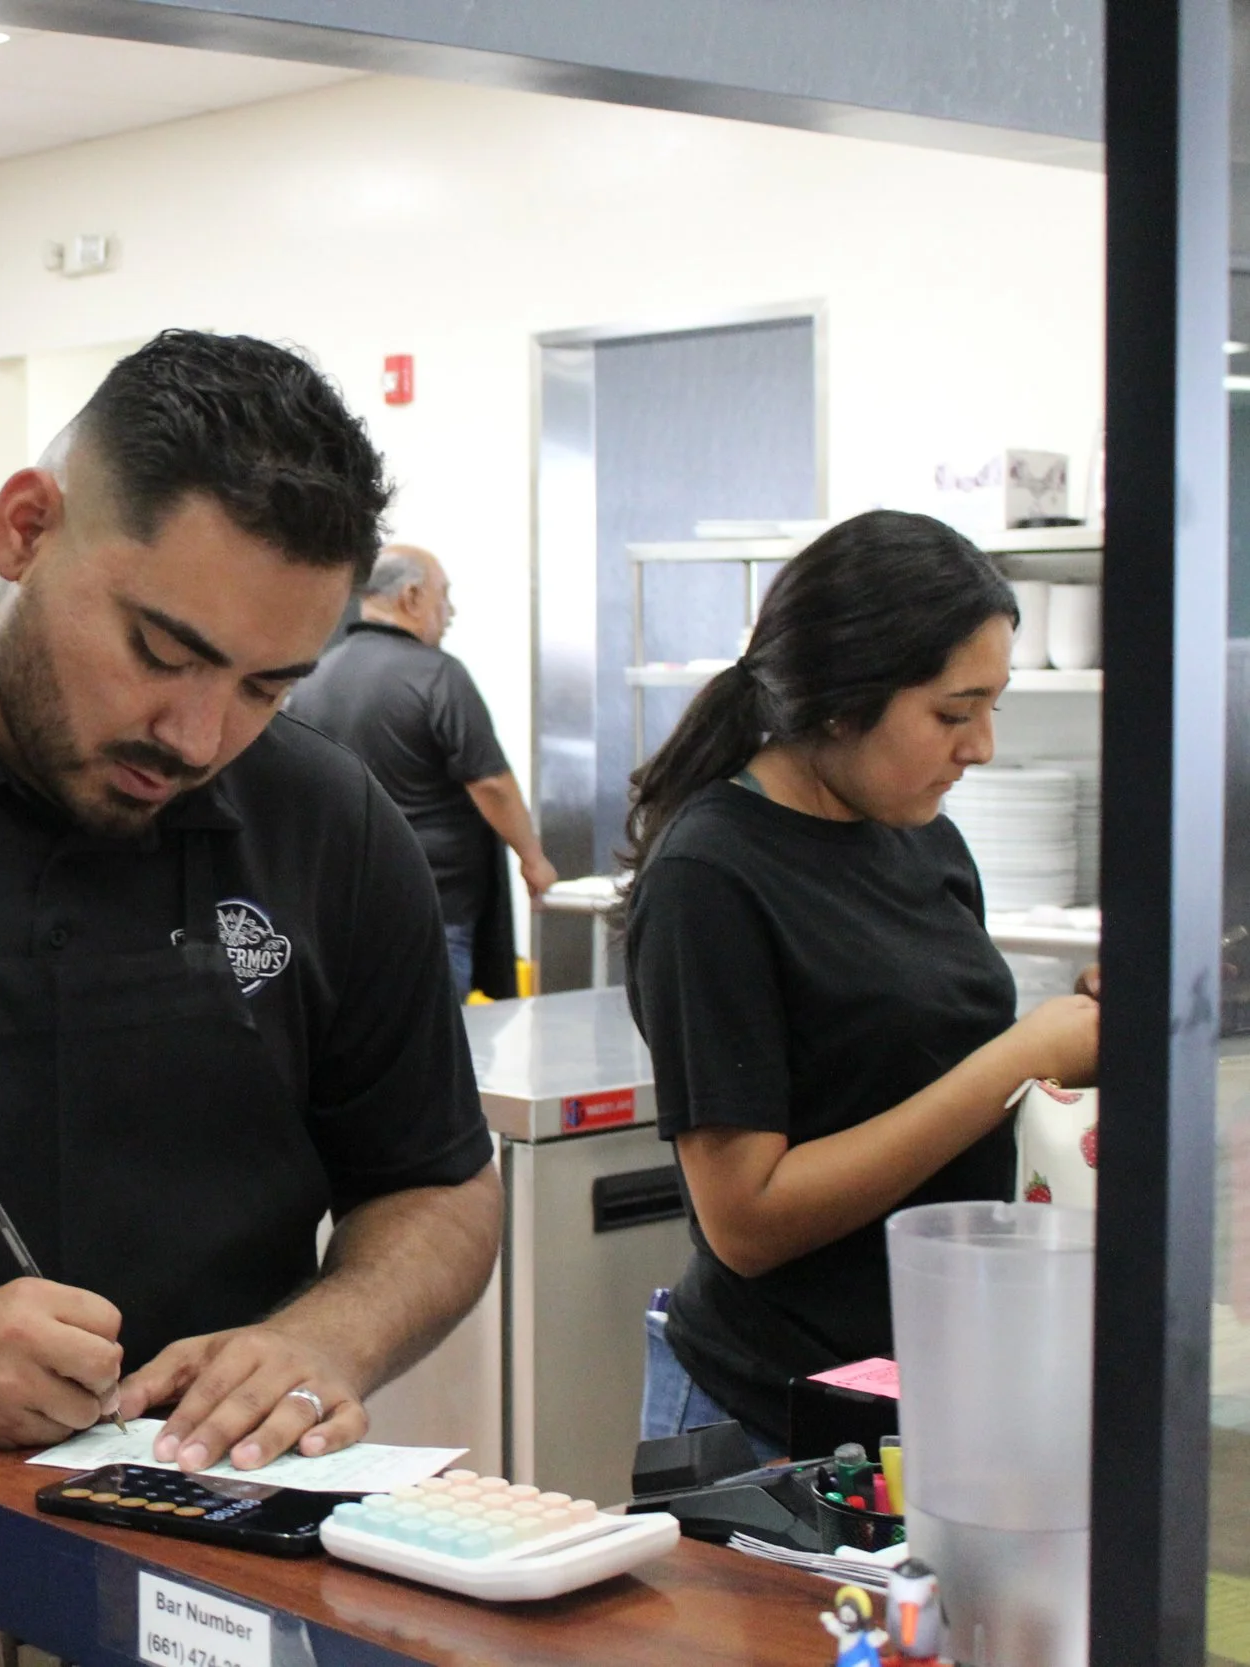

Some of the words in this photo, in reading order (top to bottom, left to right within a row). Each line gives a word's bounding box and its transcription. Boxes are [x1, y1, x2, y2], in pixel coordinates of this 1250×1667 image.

[156, 1591, 182, 1611] Bar
[186, 1601, 253, 1641] Number
[147, 1631, 184, 1665] (661)
[188, 1648, 241, 1667] 474-
